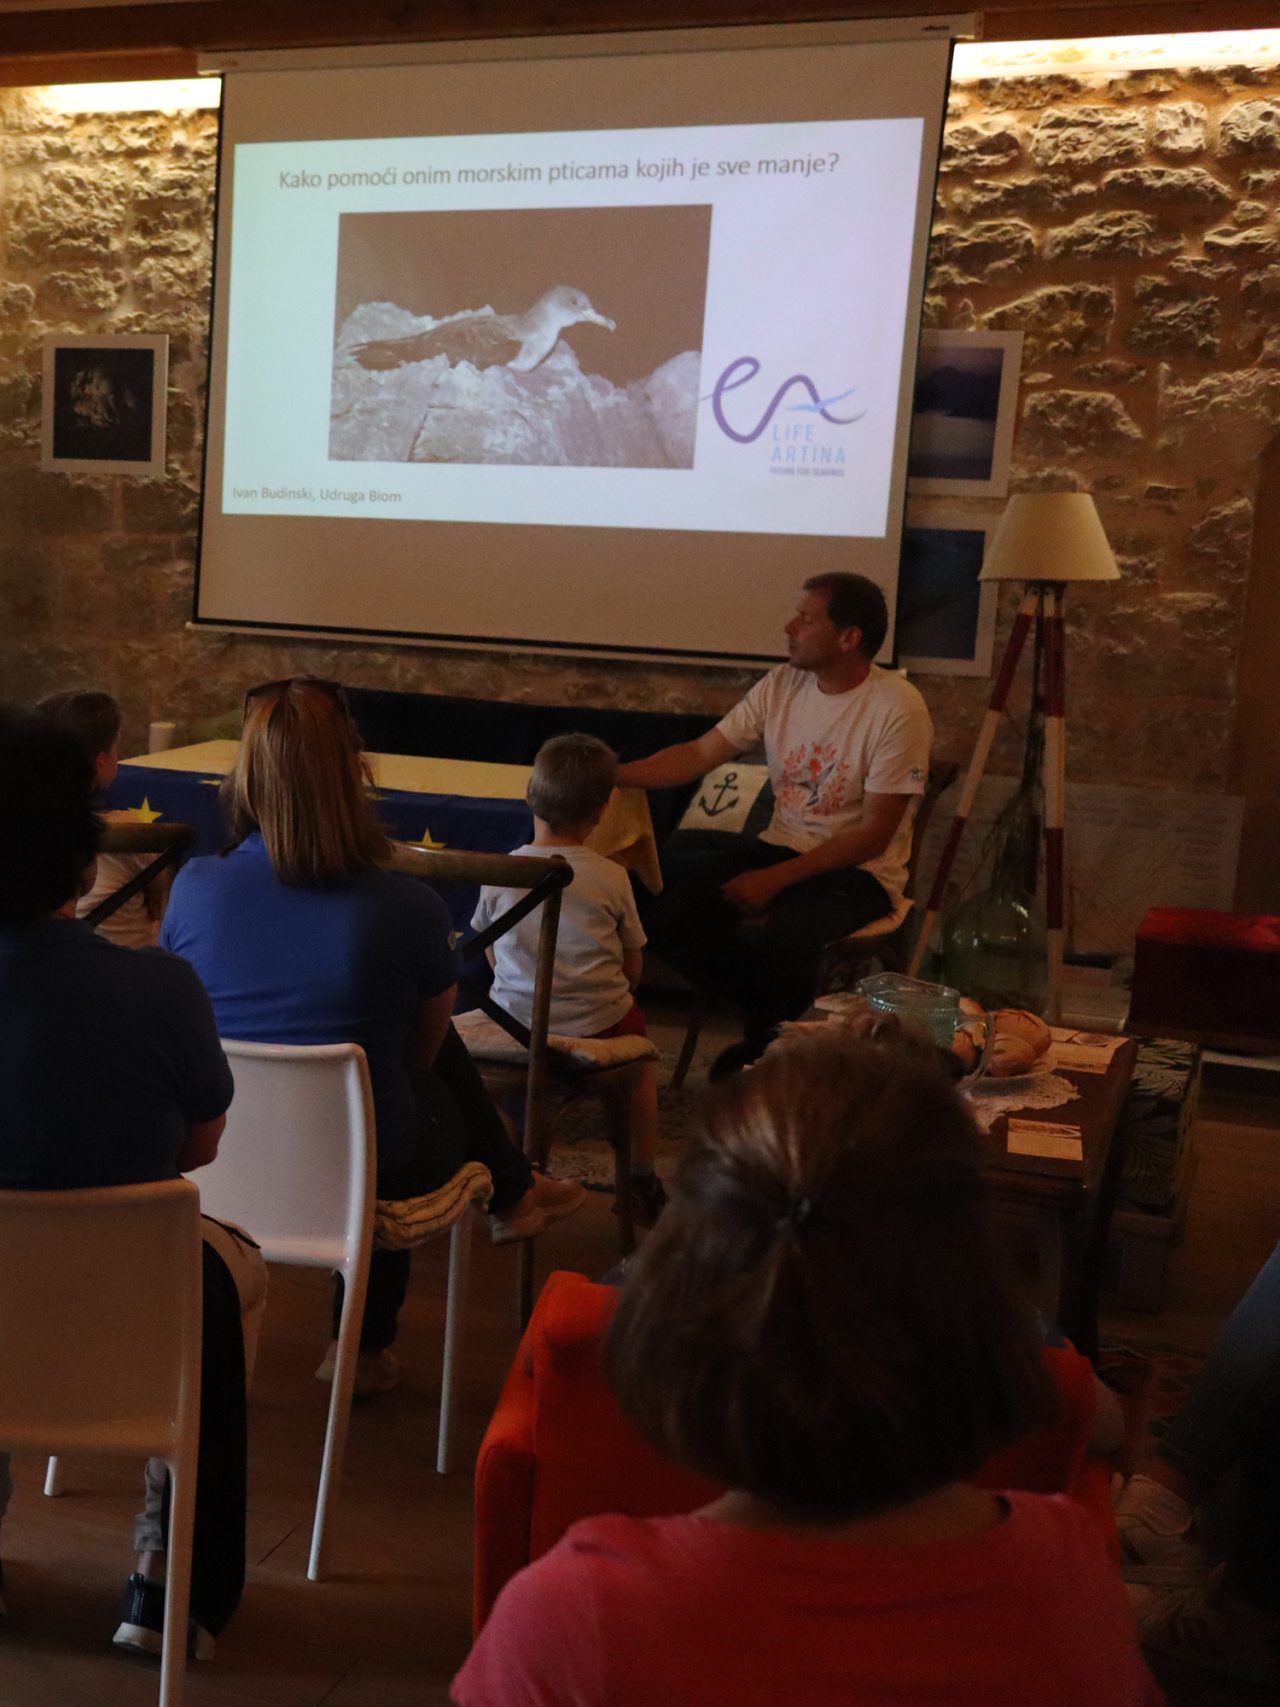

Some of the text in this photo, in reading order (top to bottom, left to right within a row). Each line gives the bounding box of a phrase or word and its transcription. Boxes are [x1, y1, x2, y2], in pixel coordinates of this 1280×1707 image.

[279, 153, 840, 190] Kako pomoći onim morskim pticama kojih je sve manje?
[773, 424, 815, 441] LIFE
[771, 446, 846, 464] ARTINA
[232, 487, 402, 504] Ivan Budinski, Udruga Biom
